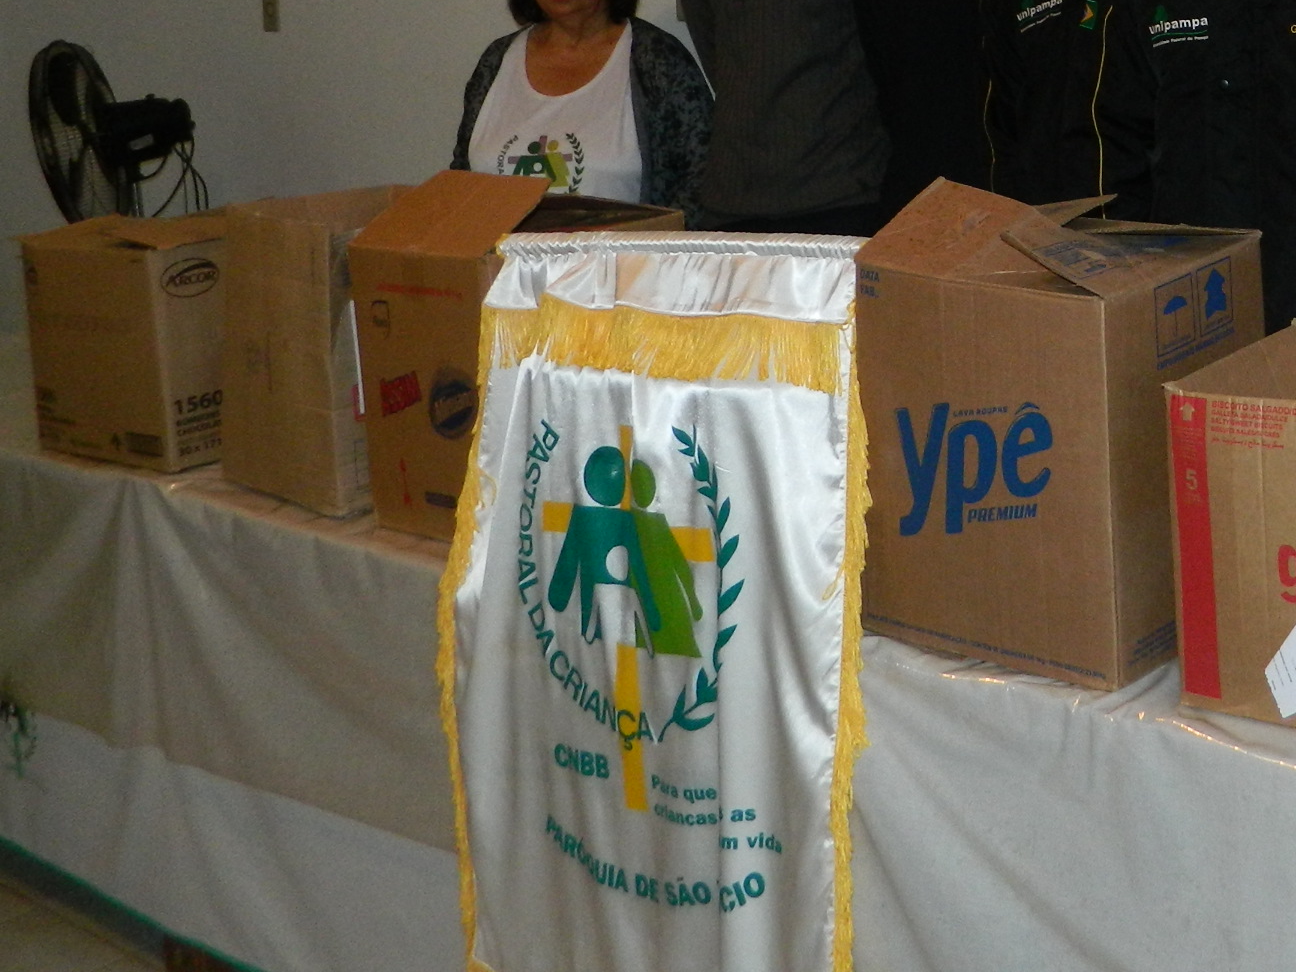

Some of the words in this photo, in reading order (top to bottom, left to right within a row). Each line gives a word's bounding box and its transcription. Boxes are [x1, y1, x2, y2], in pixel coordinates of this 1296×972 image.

[1148, 17, 1209, 34] unipampa
[174, 389, 223, 415] 1560
[953, 409, 975, 418] LAVA
[976, 406, 1009, 416] ROUPAS
[1211, 400, 1249, 411] BISCOITO
[1185, 468, 1198, 491] 5
[517, 418, 560, 605] PASTORAL
[967, 503, 1038, 524] PREMIUM
[527, 602, 556, 658] DA
[549, 649, 655, 751] CRIANÇA
[553, 743, 611, 779] CNBB
[683, 785, 718, 804] que
[746, 832, 784, 855] vida
[635, 873, 660, 904] DE
[664, 877, 712, 907] SÃO
[718, 872, 767, 914] CIO
